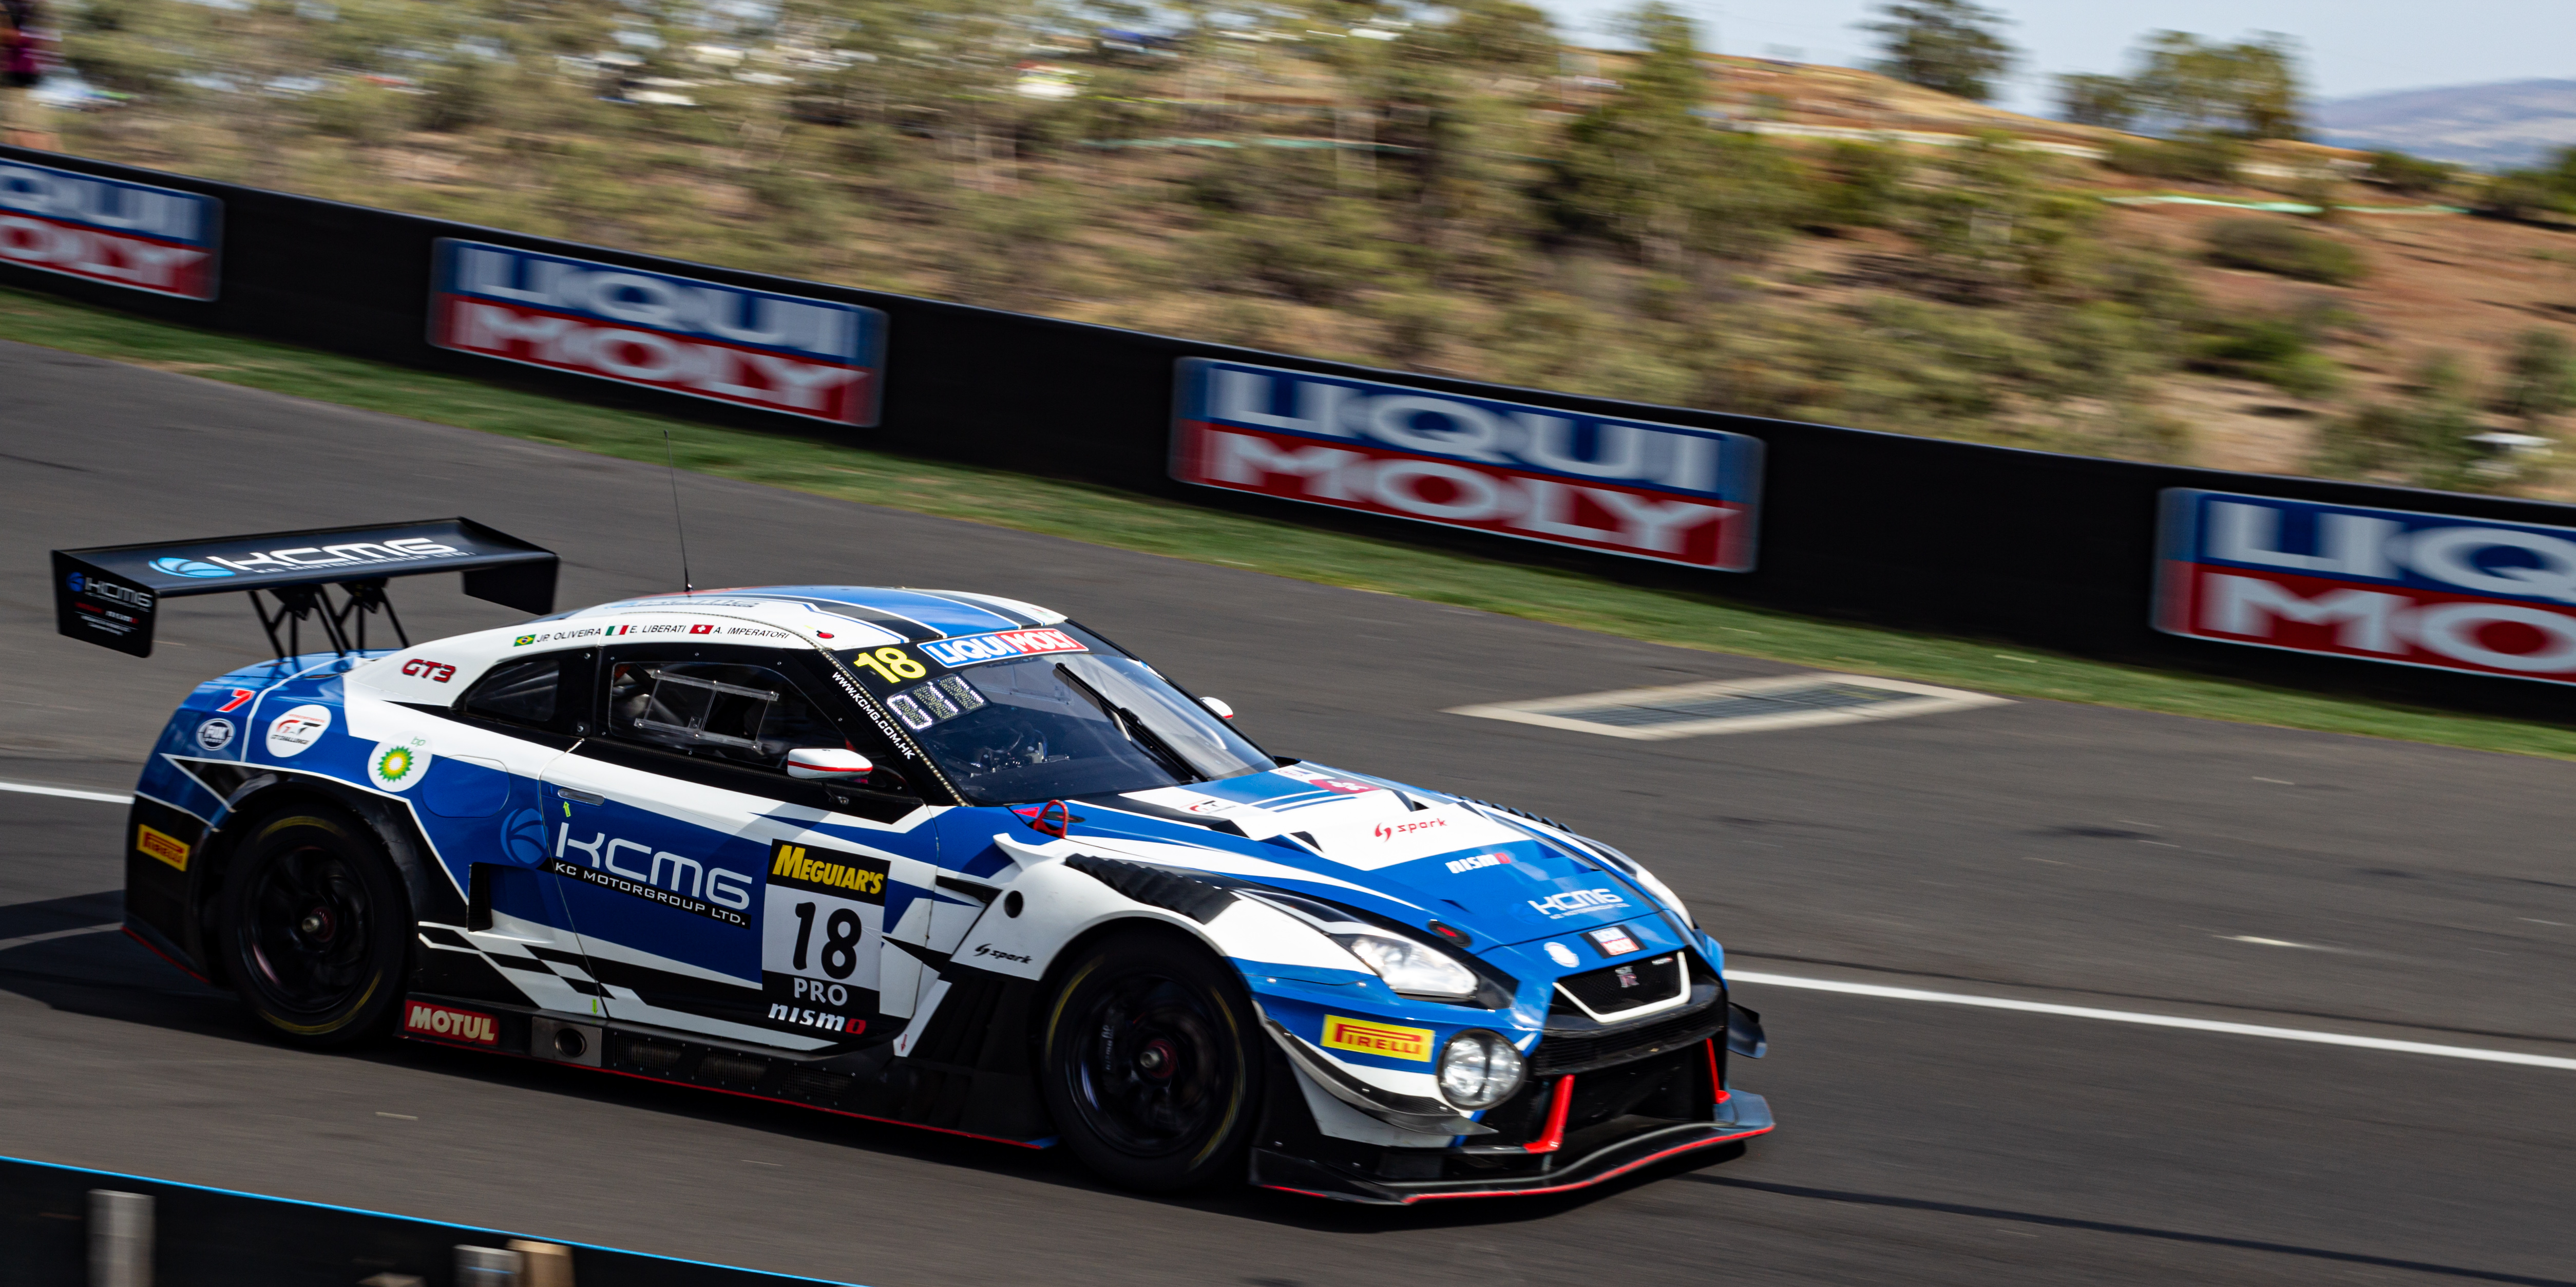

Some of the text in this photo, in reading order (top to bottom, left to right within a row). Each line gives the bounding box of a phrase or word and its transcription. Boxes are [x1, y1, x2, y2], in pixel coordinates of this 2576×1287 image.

[455, 246, 861, 359] LIQUI
[451, 300, 871, 411] MOLY
[1205, 368, 1721, 493] LIQUI
[1200, 428, 1744, 554] MOLY
[206, 538, 459, 571] KCMG
[554, 628, 602, 640] OLIVEIRA
[642, 624, 686, 633] LIBERATI
[727, 628, 790, 639] IMPERATORI
[926, 630, 1078, 664] LIQUI MOLY
[401, 658, 456, 684] GT3
[853, 647, 926, 683] 18
[216, 689, 257, 712] 7
[832, 671, 915, 760] WWW.KCMG.COM.HK
[411, 736, 426, 747] bp
[1397, 818, 1448, 833] spark
[143, 831, 183, 864] PIRELLI
[556, 822, 753, 910] KCMG
[772, 844, 884, 894] MEGUIAR'S
[555, 862, 746, 925] KC MOTORGROUP LTD.
[792, 901, 862, 979] 18
[989, 950, 1034, 964] spark
[793, 977, 848, 1006] PRO
[408, 1005, 495, 1041] MOTUL
[1333, 1023, 1422, 1055] PIRELLI
